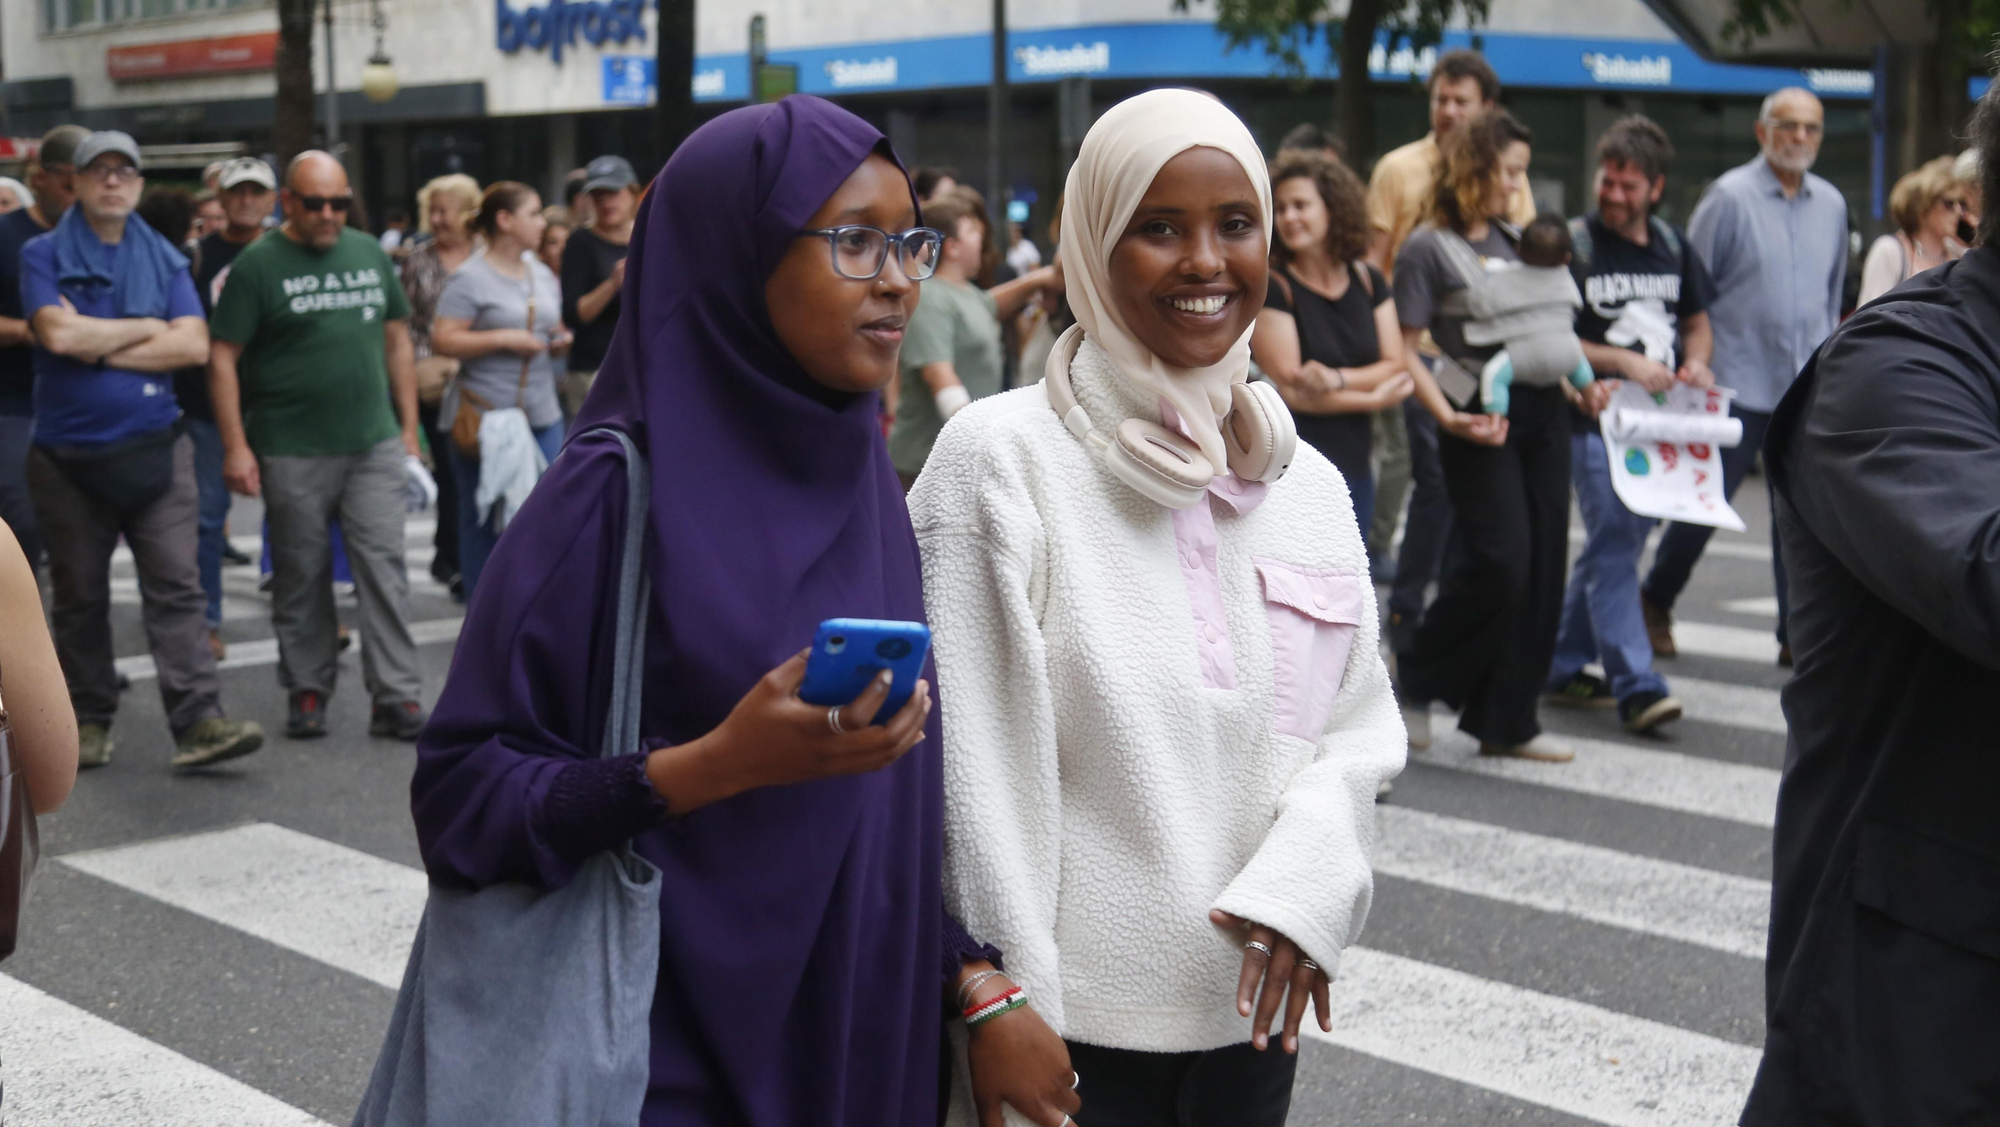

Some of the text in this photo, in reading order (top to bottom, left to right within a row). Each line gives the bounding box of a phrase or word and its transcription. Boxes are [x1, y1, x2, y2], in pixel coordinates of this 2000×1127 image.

[283, 268, 381, 296] NO A LAS
[290, 287, 386, 314] GUERRAS
